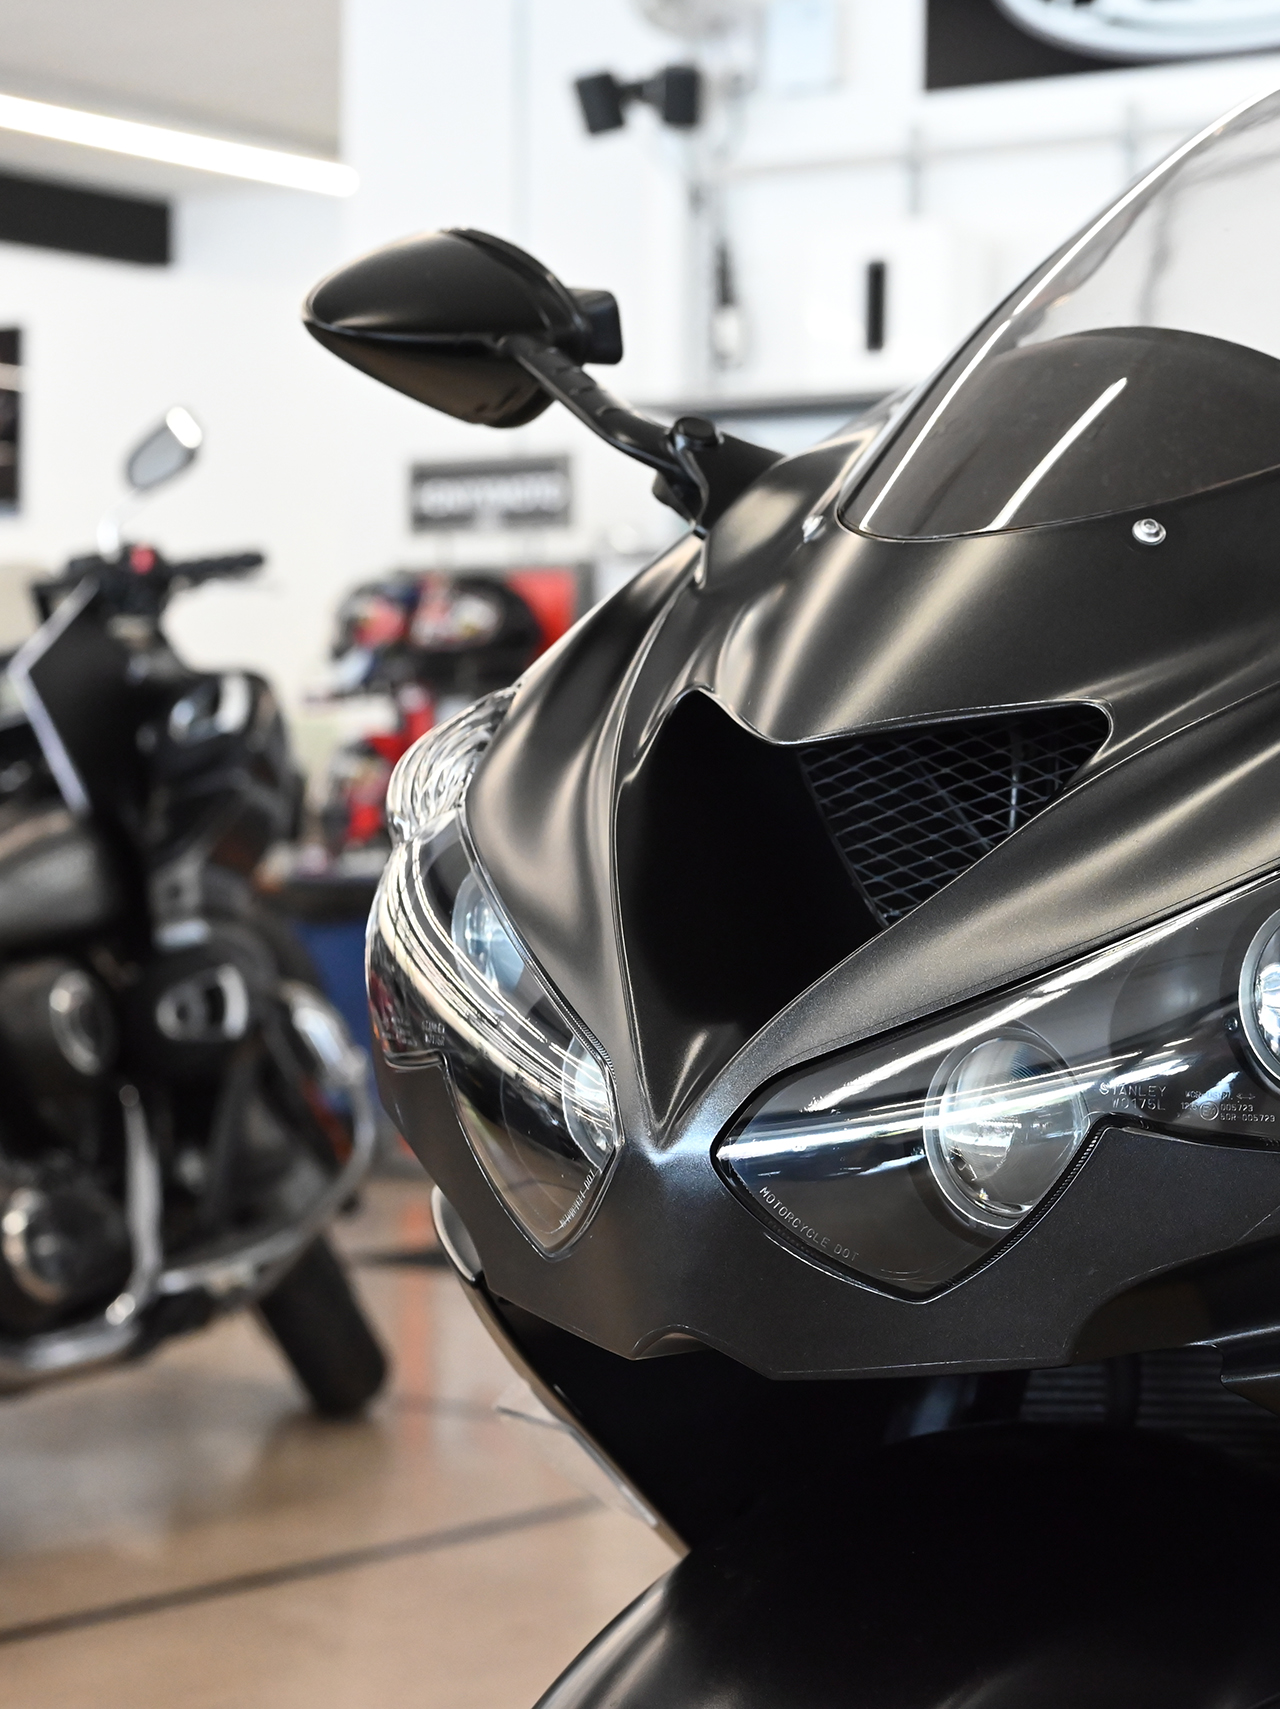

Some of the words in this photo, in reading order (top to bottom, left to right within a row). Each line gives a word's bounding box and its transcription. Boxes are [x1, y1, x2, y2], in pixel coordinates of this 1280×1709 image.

[1099, 1082, 1166, 1097] STANLEY
[760, 1186, 830, 1248] MOTORCYCLE
[834, 1243, 859, 1261] DOT
